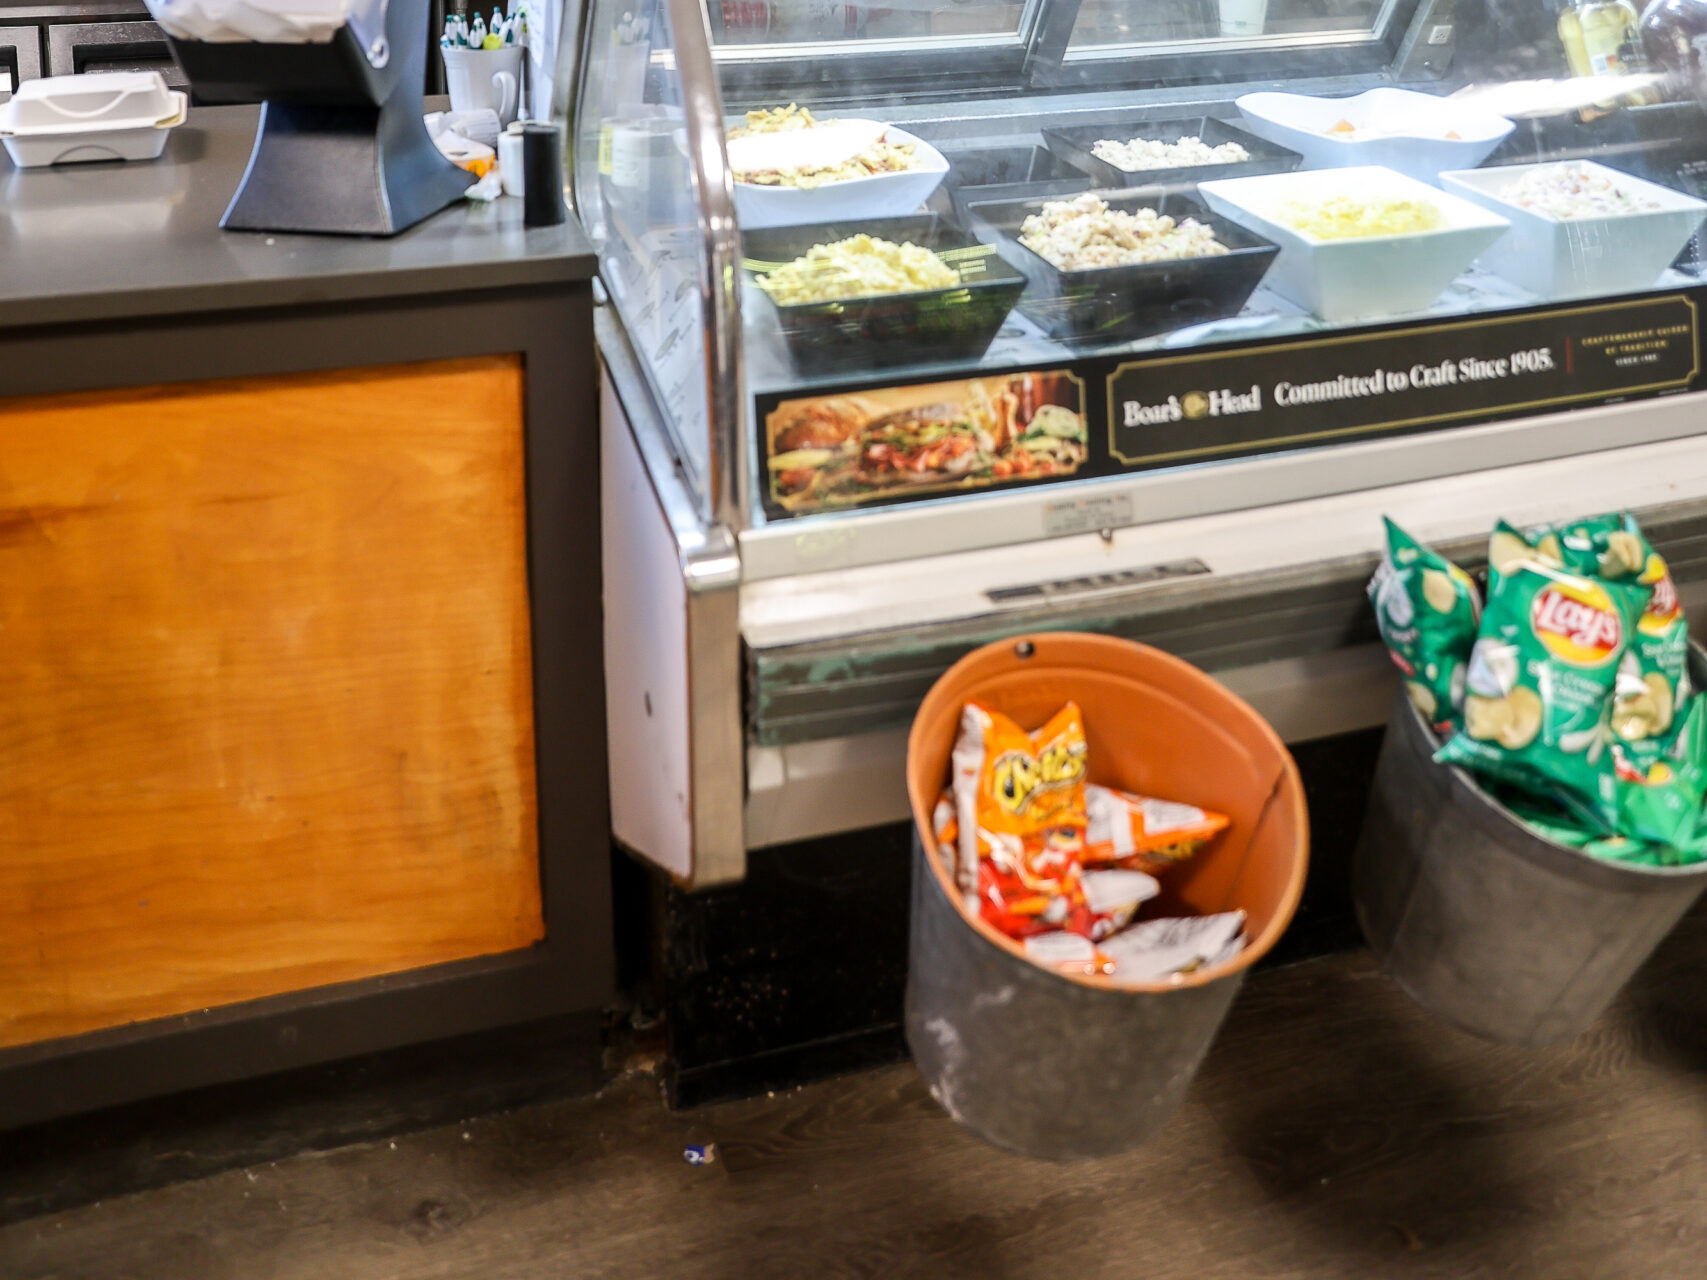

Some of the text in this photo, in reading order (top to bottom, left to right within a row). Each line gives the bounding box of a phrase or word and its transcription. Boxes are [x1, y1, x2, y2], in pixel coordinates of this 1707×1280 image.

[1124, 347, 1554, 427] Boar's Head Committed to Craft Since 1905.
